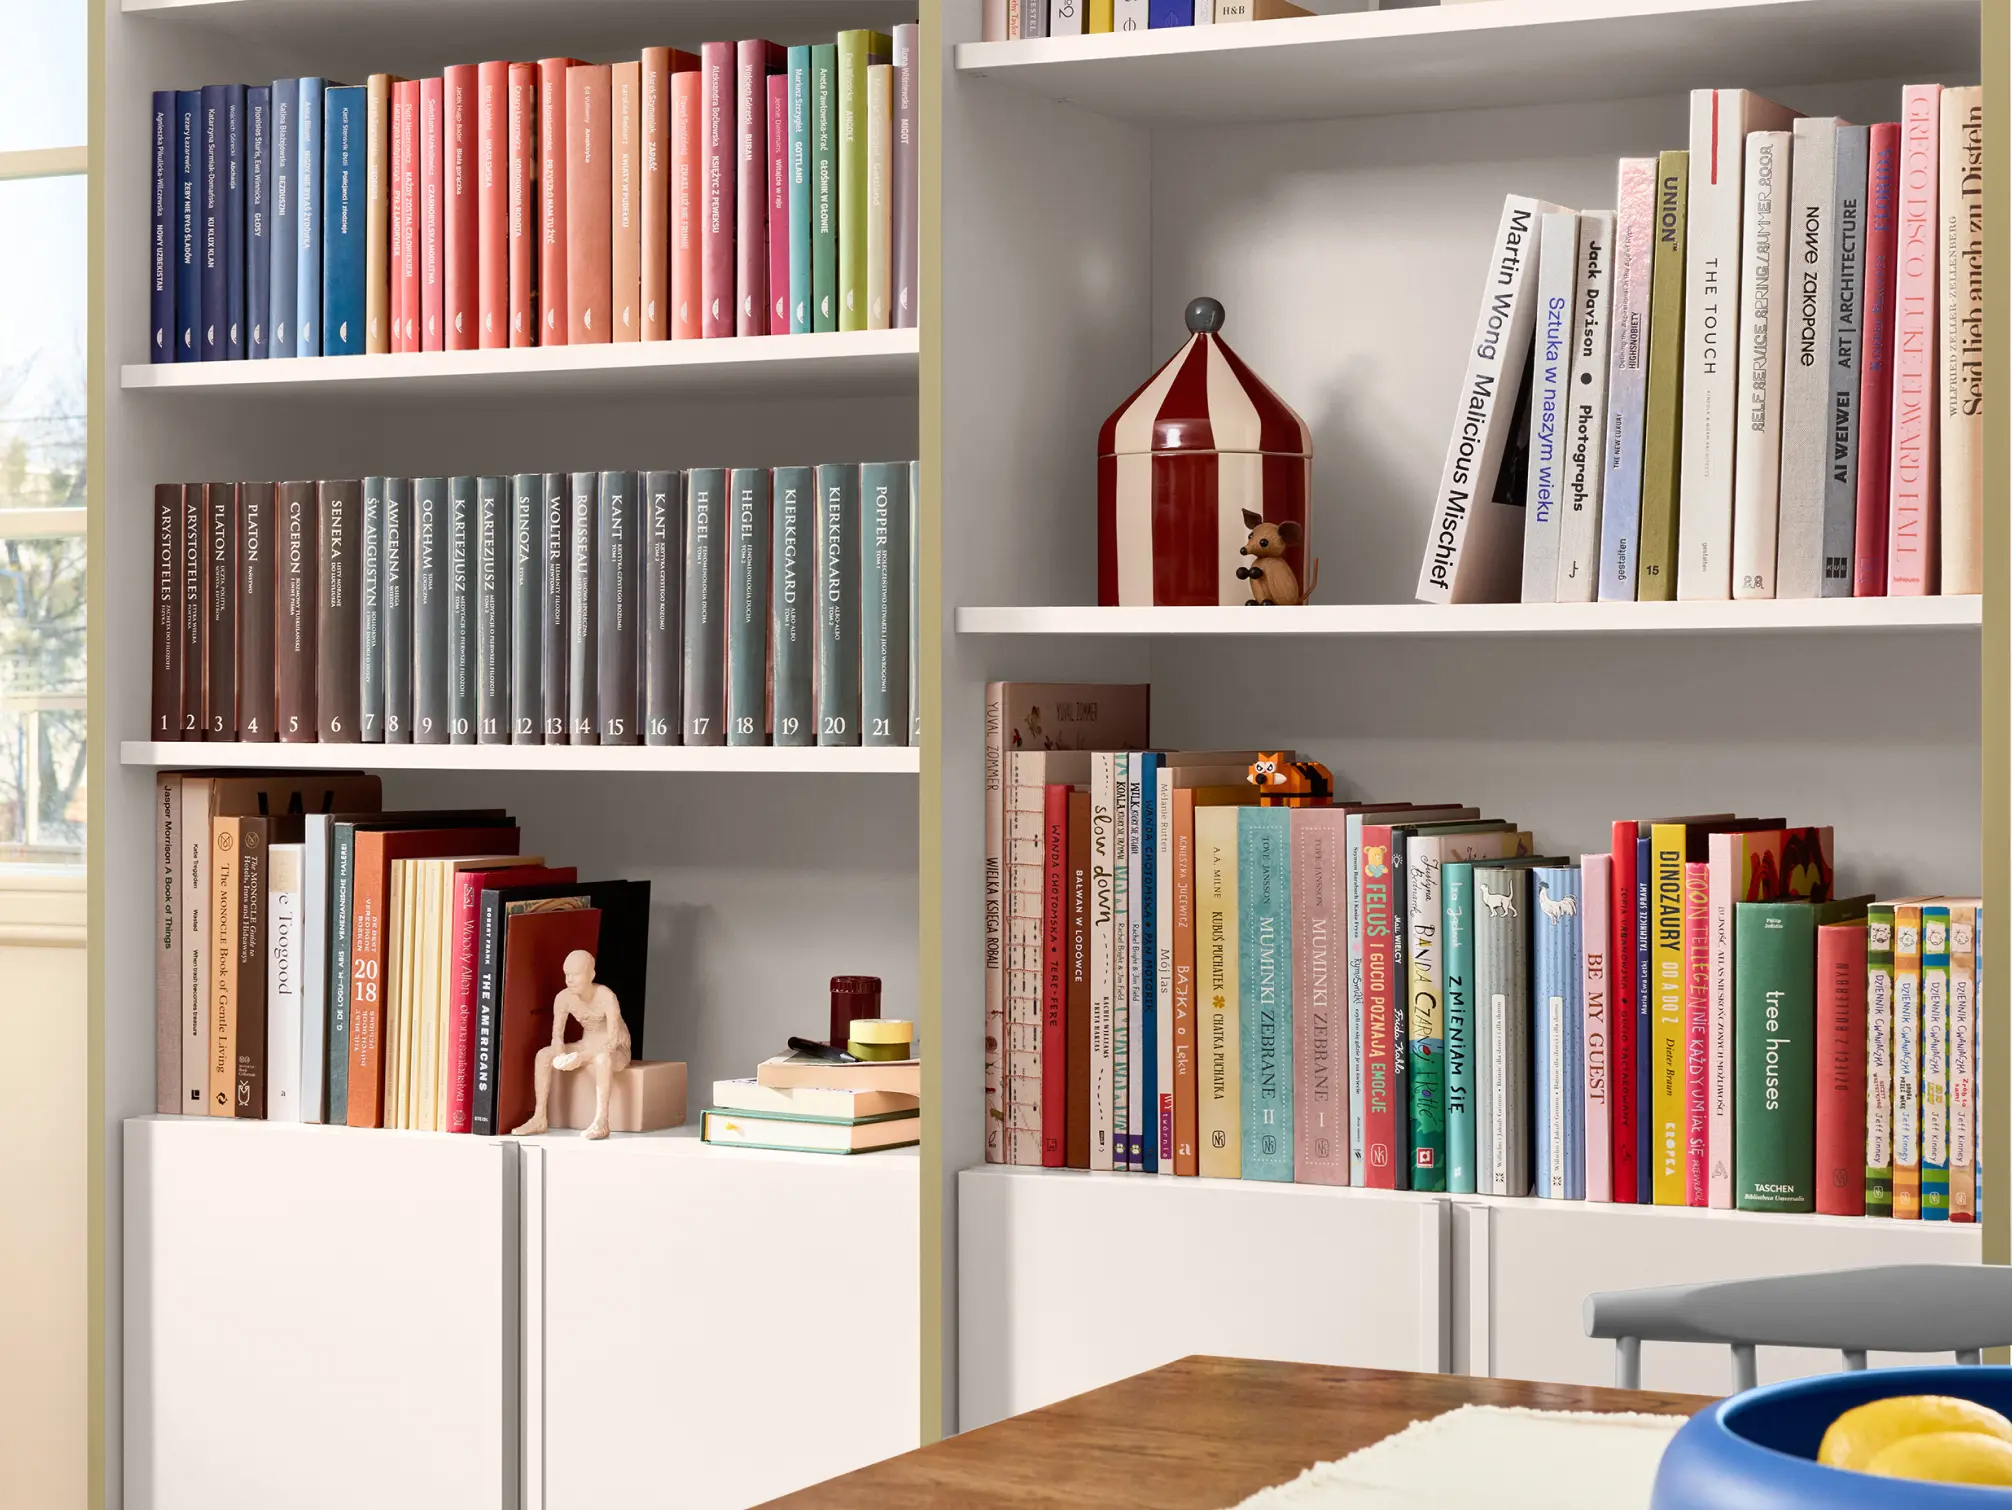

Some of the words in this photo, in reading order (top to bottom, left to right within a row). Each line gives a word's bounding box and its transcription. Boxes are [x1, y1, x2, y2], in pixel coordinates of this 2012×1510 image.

[1223, 6, 1245, 16] H&B
[712, 65, 720, 106] Aleksandra
[795, 69, 803, 96] Mariusz
[820, 69, 828, 88] Aneta
[712, 108, 720, 146] Boćkowska
[794, 99, 803, 132] Szczygieł
[820, 91, 829, 150] Pawłowska-Krać
[1909, 98, 1930, 190] GRECO
[710, 156, 720, 188] KSIĘŻYC
[820, 160, 829, 193] GŁOŚNIK
[1498, 210, 1531, 285] Martin
[1906, 200, 1927, 278] DISCO
[1587, 241, 1601, 279] Jack
[1705, 259, 1717, 296] THE
[1838, 199, 1857, 323] ARCHITECTURE
[1477, 293, 1513, 361] Wong
[1545, 297, 1565, 361] Sztuka
[1582, 289, 1599, 357] Davison
[1629, 312, 1639, 369] HIGHSNOBIETY
[1704, 305, 1717, 374] TOUCH
[1903, 297, 1925, 364] LUKE
[1838, 339, 1852, 368] ART
[1545, 367, 1558, 384] w
[1453, 375, 1494, 484] Malicious
[1539, 389, 1558, 461] naszym
[1834, 391, 1850, 460] WEIWEI
[1898, 373, 1920, 483] EDWARD
[1572, 405, 1592, 511] Photographs
[1834, 464, 1849, 483] AI
[1536, 467, 1556, 522] wieku
[248, 504, 258, 561] PLATON
[331, 500, 342, 558] SENEKA
[423, 500, 432, 568] OCKHAM
[519, 496, 529, 562] SPINOZA
[655, 493, 665, 538] KANT
[698, 491, 708, 542] HEGEL
[876, 486, 887, 546] POPPER
[1896, 493, 1919, 562] HALL
[162, 505, 171, 600] ARYSTOTELES
[291, 502, 300, 573] CYCERON
[455, 499, 465, 591] KARTEZJUSZ
[829, 487, 840, 601] KIERKEGAARD
[1429, 490, 1468, 589] Mischief
[1617, 539, 1628, 580] gestalten
[1647, 566, 1660, 575] 15
[162, 715, 167, 730] 1
[248, 718, 258, 733] 4
[290, 716, 298, 732] 5
[331, 716, 341, 732] 6
[423, 718, 431, 733] 9
[452, 719, 468, 734] 10
[516, 718, 532, 734] 12
[651, 719, 667, 735] 16
[693, 718, 709, 734] 17
[824, 718, 845, 734] 20
[873, 719, 890, 735] 21
[163, 785, 172, 819] Jasper
[1160, 783, 1170, 820] Mélanie
[164, 821, 173, 864] Morrison
[1050, 825, 1060, 867] WANDA
[1093, 806, 1111, 856] slow
[1161, 823, 1169, 852] Rutten
[1262, 837, 1271, 861] TOVE
[165, 866, 172, 874] A
[219, 864, 230, 887] The
[1213, 847, 1221, 866] A.A.
[165, 877, 173, 902] Book
[987, 858, 999, 896] WIELKA
[1092, 865, 1114, 926] down
[1213, 870, 1222, 898] MILNE
[1262, 865, 1271, 904] JANSSON
[165, 905, 172, 915] of
[220, 891, 228, 944] MONOCLE
[985, 899, 1000, 934] KSIĘGA
[1050, 872, 1060, 943] CHOTOMSKA
[1366, 884, 1389, 937] FELUŚ
[1659, 851, 1680, 951] DINOZAURY
[164, 917, 173, 948] Things
[1076, 916, 1083, 926] W
[1211, 912, 1225, 941] KUBUŚ
[274, 913, 292, 995] Toogood
[460, 920, 474, 962] Woody
[1075, 930, 1085, 982] LODÓWCE
[219, 948, 229, 974] Book
[354, 959, 377, 979] 20
[1159, 949, 1171, 972] Mój
[1212, 945, 1223, 990] PUCHATEK
[1260, 917, 1272, 1005] MUMINKI
[1370, 953, 1383, 991] GUCIO
[1588, 953, 1603, 980] BE
[218, 976, 229, 992] of
[355, 982, 377, 1002] 18
[461, 965, 473, 995] Allen
[482, 973, 491, 999] THE
[1048, 961, 1060, 1027] TERE-FERE
[1160, 975, 1170, 993] las
[217, 995, 228, 1032] Gentle
[1589, 992, 1604, 1022] MY
[1766, 991, 1783, 1031] tree
[1957, 981, 1966, 1023] DZIENNIK
[459, 1004, 468, 1042] obrona
[1212, 1014, 1224, 1049] CHATKA
[1368, 997, 1384, 1057] POZNAJĄ
[217, 1037, 228, 1073] Living
[479, 1005, 489, 1091] AMERICANS
[1261, 1012, 1275, 1099] ZEBRANE
[1665, 1038, 1675, 1065] Dieter
[1212, 1053, 1224, 1100] PUCHATKA
[1589, 1033, 1604, 1104] GUEST
[1666, 1069, 1675, 1096] Braun
[1766, 1039, 1790, 1110] houses
[1371, 1063, 1386, 1113] EMOCJE
[1263, 1109, 1275, 1124] II
[1957, 1112, 1966, 1131] Jeff
[1665, 1123, 1674, 1176] KROPKA
[1956, 1135, 1965, 1161] Kinney
[1754, 1184, 1794, 1192] TASCHEN
